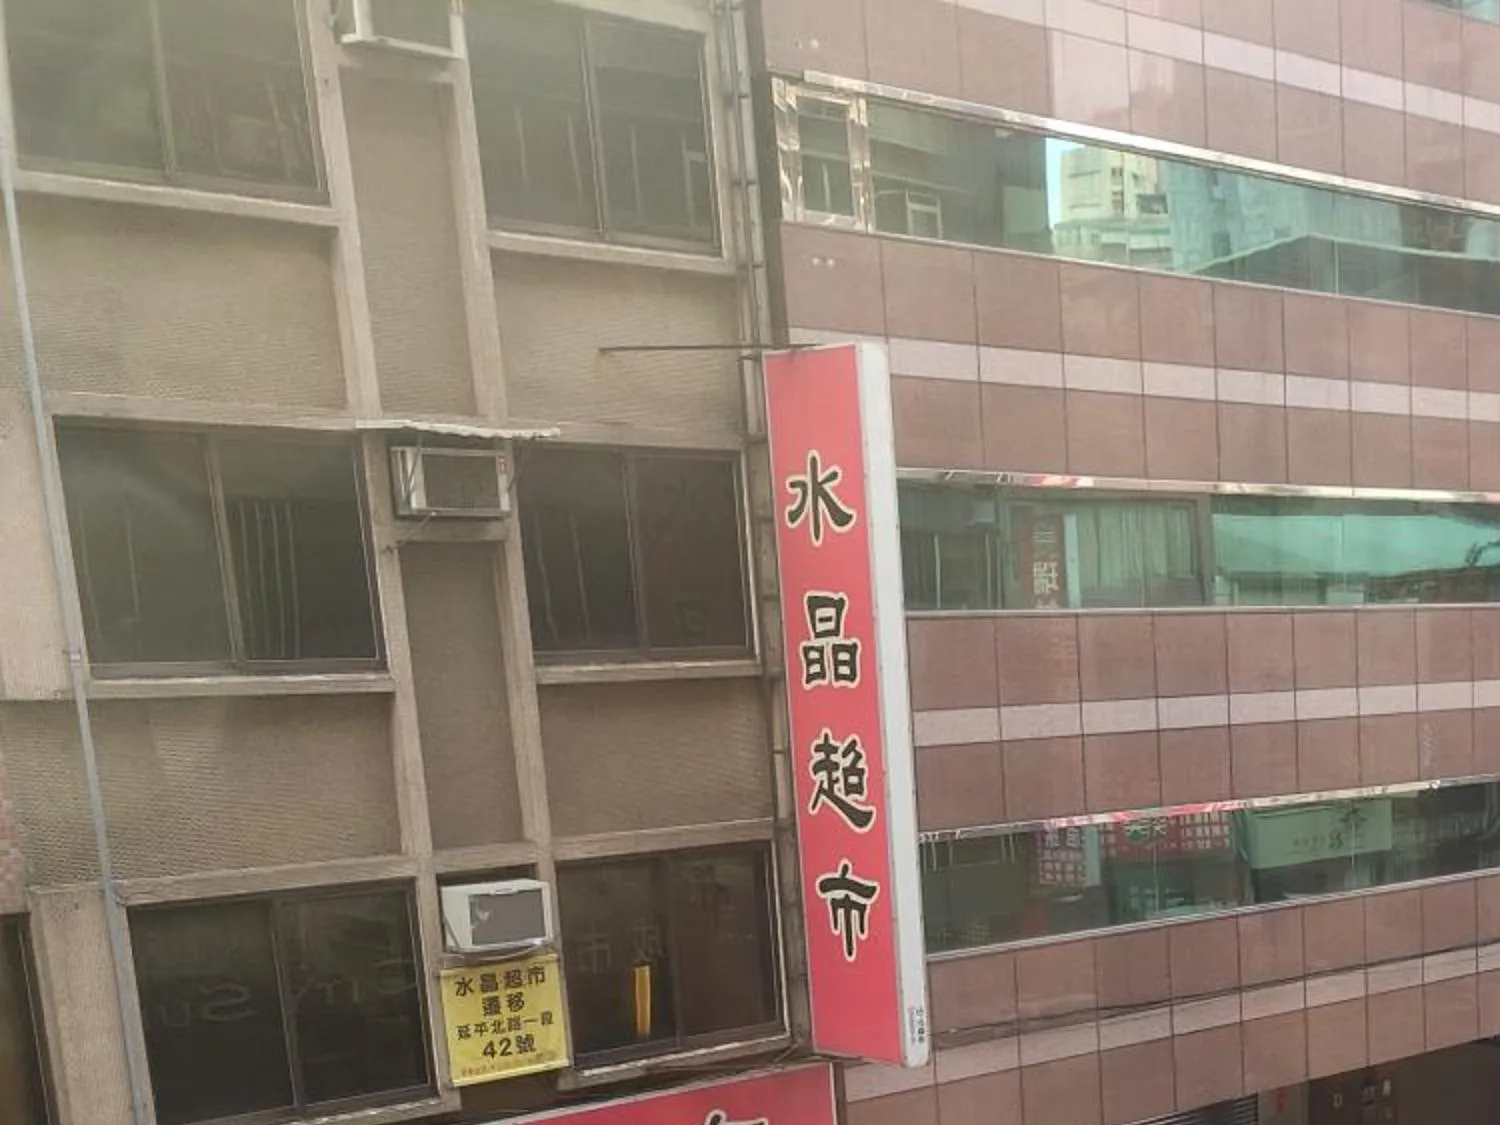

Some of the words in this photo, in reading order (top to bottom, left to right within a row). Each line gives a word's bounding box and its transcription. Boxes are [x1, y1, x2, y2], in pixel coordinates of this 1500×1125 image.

[786, 450, 879, 959] 水晶超市
[455, 965, 546, 997] 水晶超市
[456, 1010, 554, 1041] 延平北路一段
[482, 1034, 537, 1060] 42號
